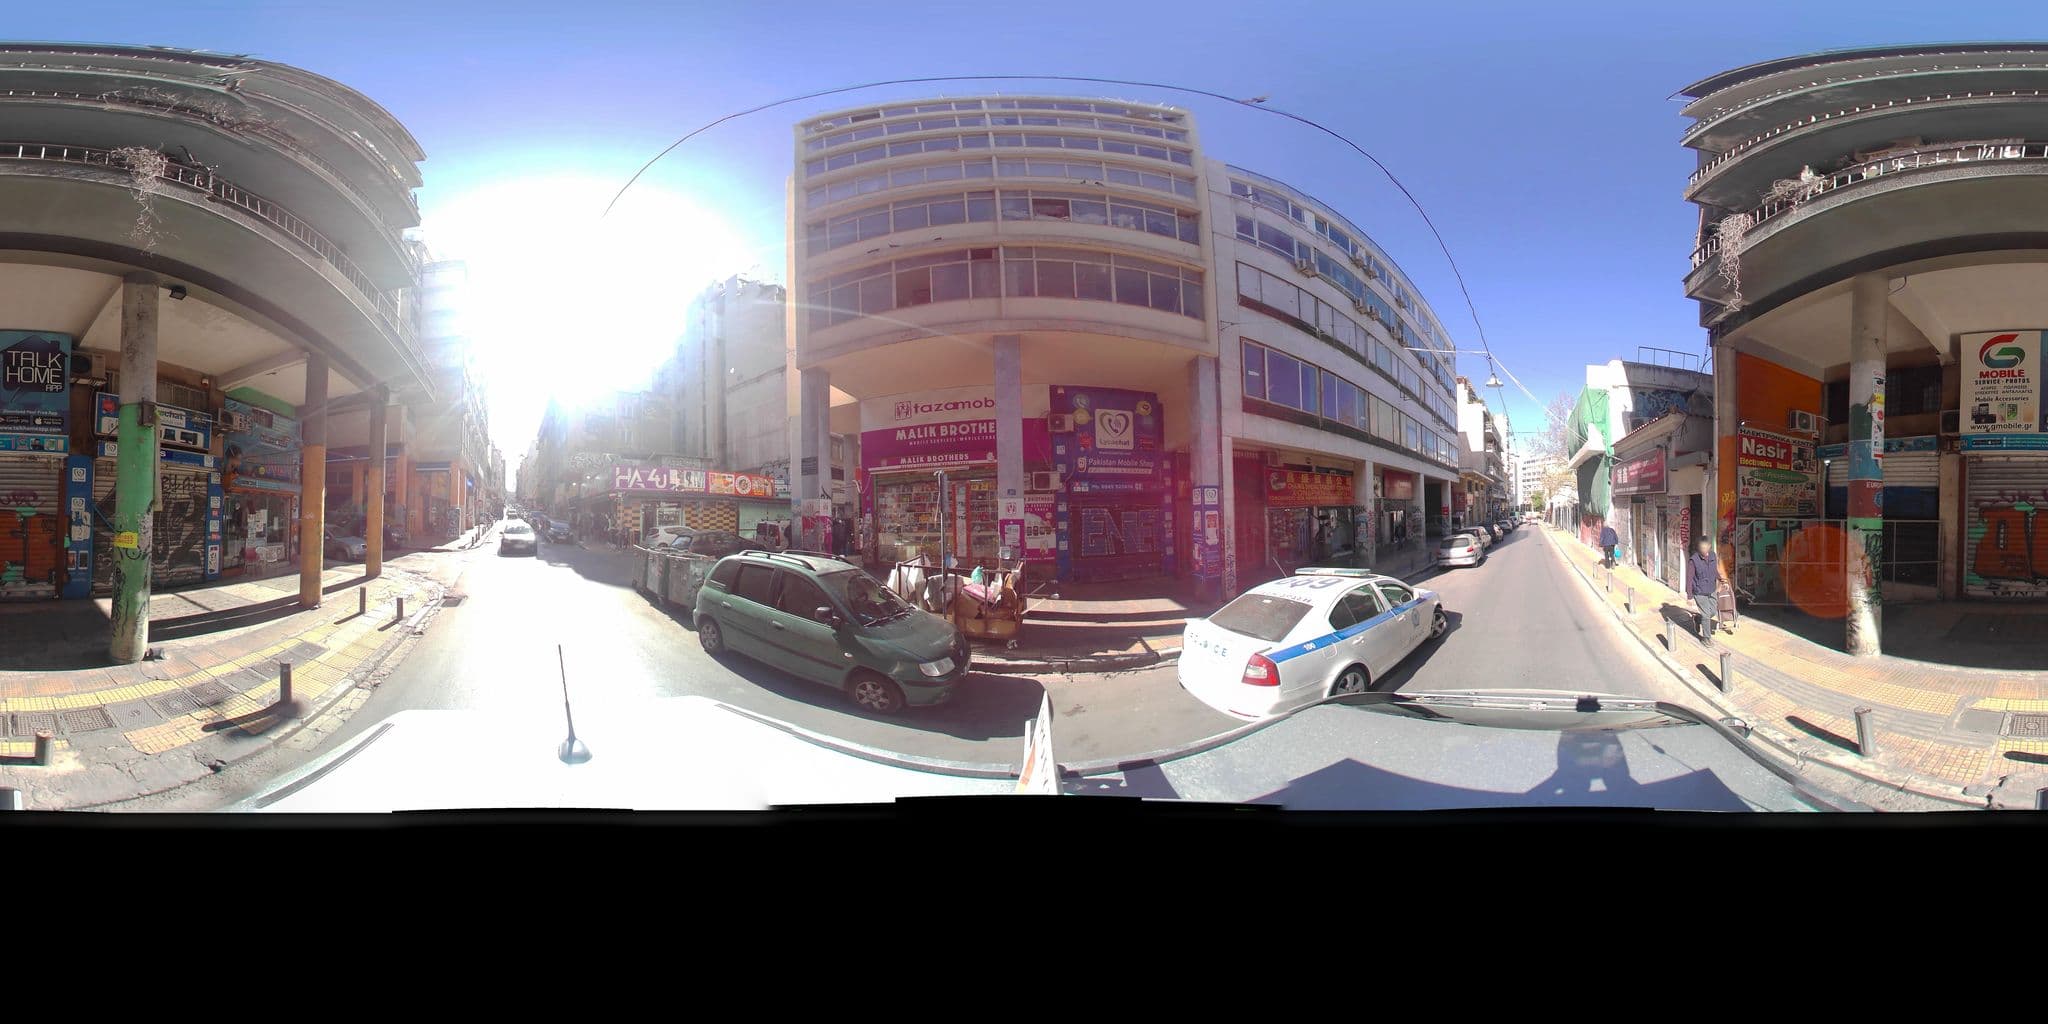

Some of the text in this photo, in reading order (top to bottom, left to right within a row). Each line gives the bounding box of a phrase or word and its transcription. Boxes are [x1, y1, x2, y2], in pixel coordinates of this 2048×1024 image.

[7, 350, 62, 369] TALK
[6, 366, 62, 385] HOME
[1979, 369, 2025, 379] MOBILE
[45, 384, 63, 392] APP
[896, 422, 995, 441] MALIK BROTHE
[1970, 422, 2032, 430] www.gmobile.gr
[1742, 437, 1788, 460] Nasir
[900, 456, 924, 464] MALIK
[927, 453, 969, 462] BROTHERS
